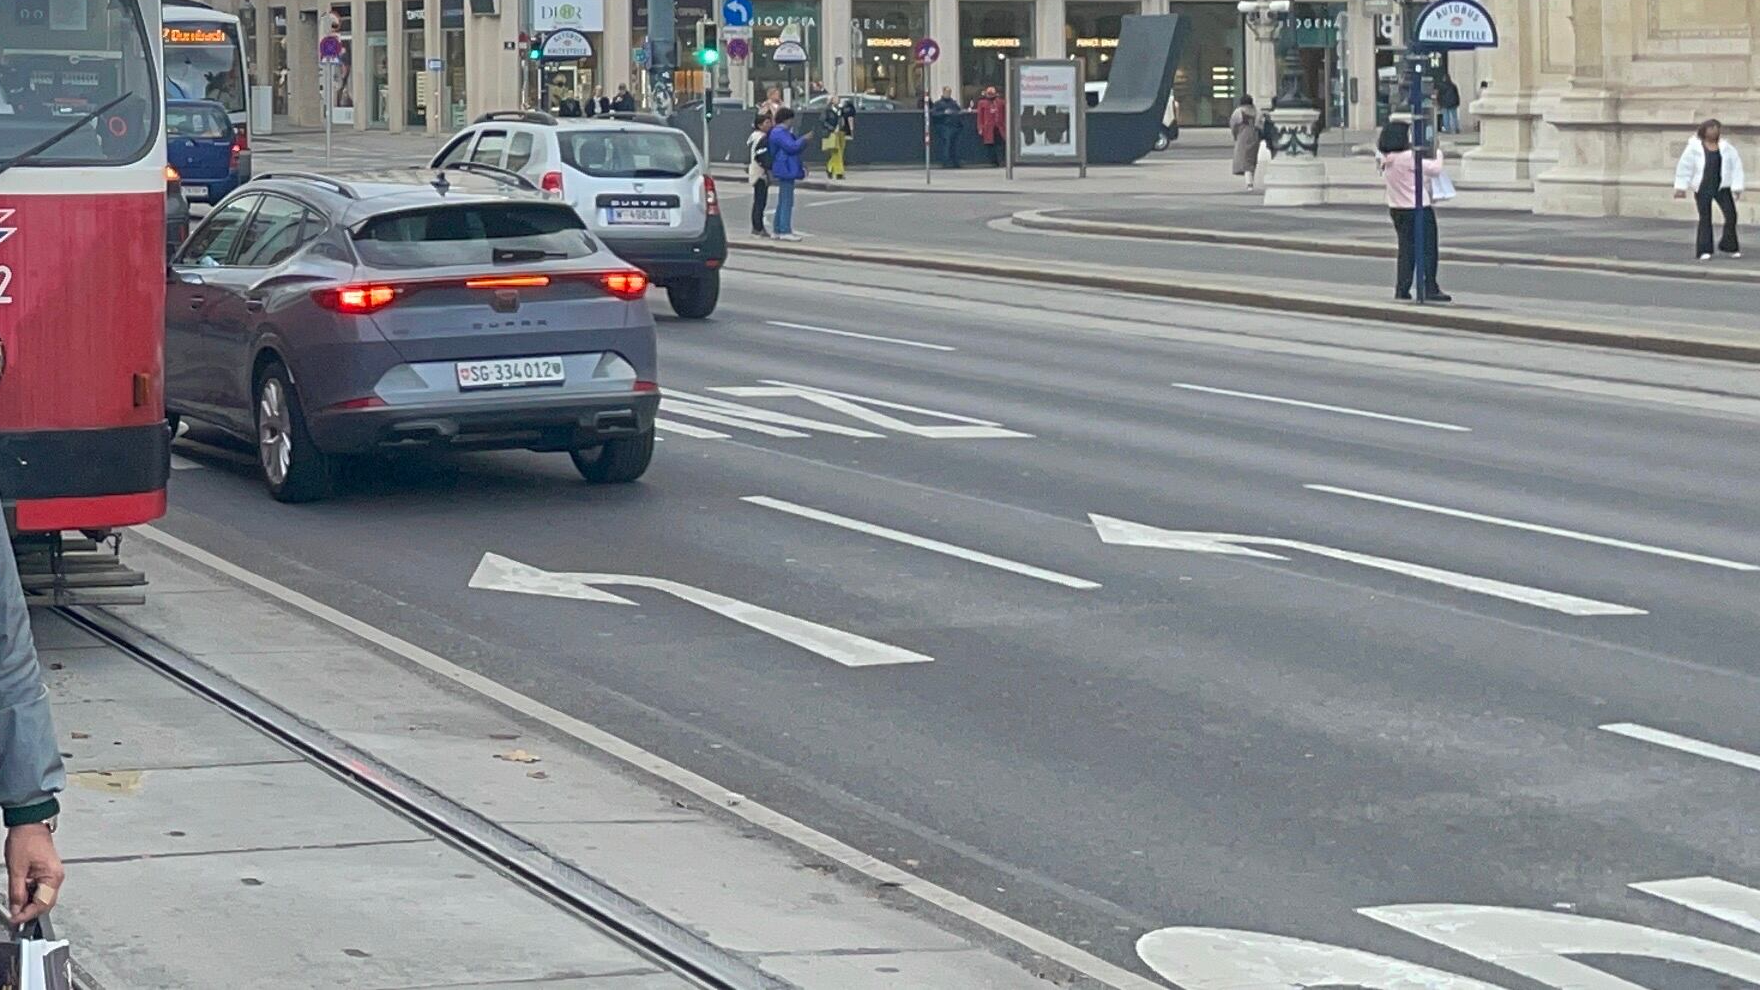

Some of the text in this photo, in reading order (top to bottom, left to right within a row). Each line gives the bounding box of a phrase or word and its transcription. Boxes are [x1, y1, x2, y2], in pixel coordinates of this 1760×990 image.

[1435, 4, 1480, 22] AUTOBUS
[1426, 29, 1487, 41] HALTESTELLE
[494, 360, 553, 379] 334012
